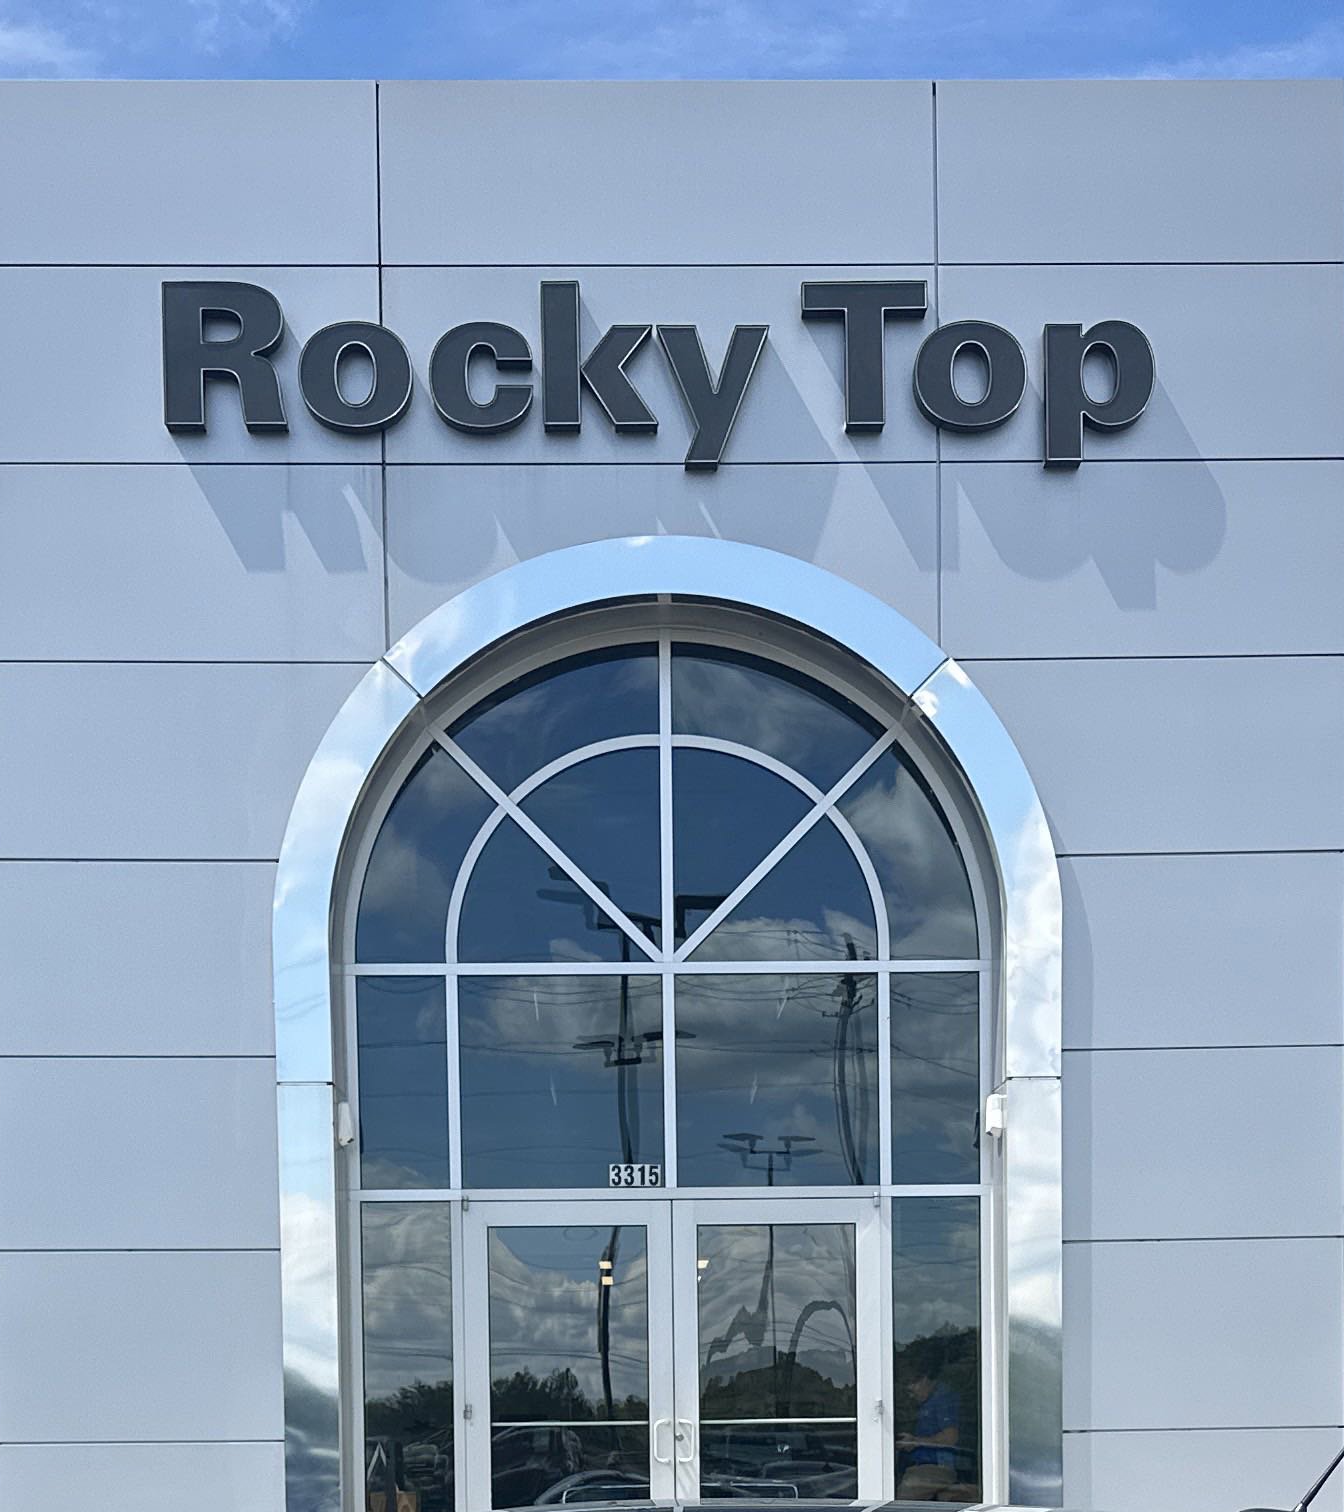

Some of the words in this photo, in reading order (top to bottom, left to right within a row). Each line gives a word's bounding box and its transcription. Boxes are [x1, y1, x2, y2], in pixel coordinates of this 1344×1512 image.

[161, 280, 770, 471] Rocky
[800, 280, 1156, 469] Top
[611, 1165, 659, 1186] 3315
